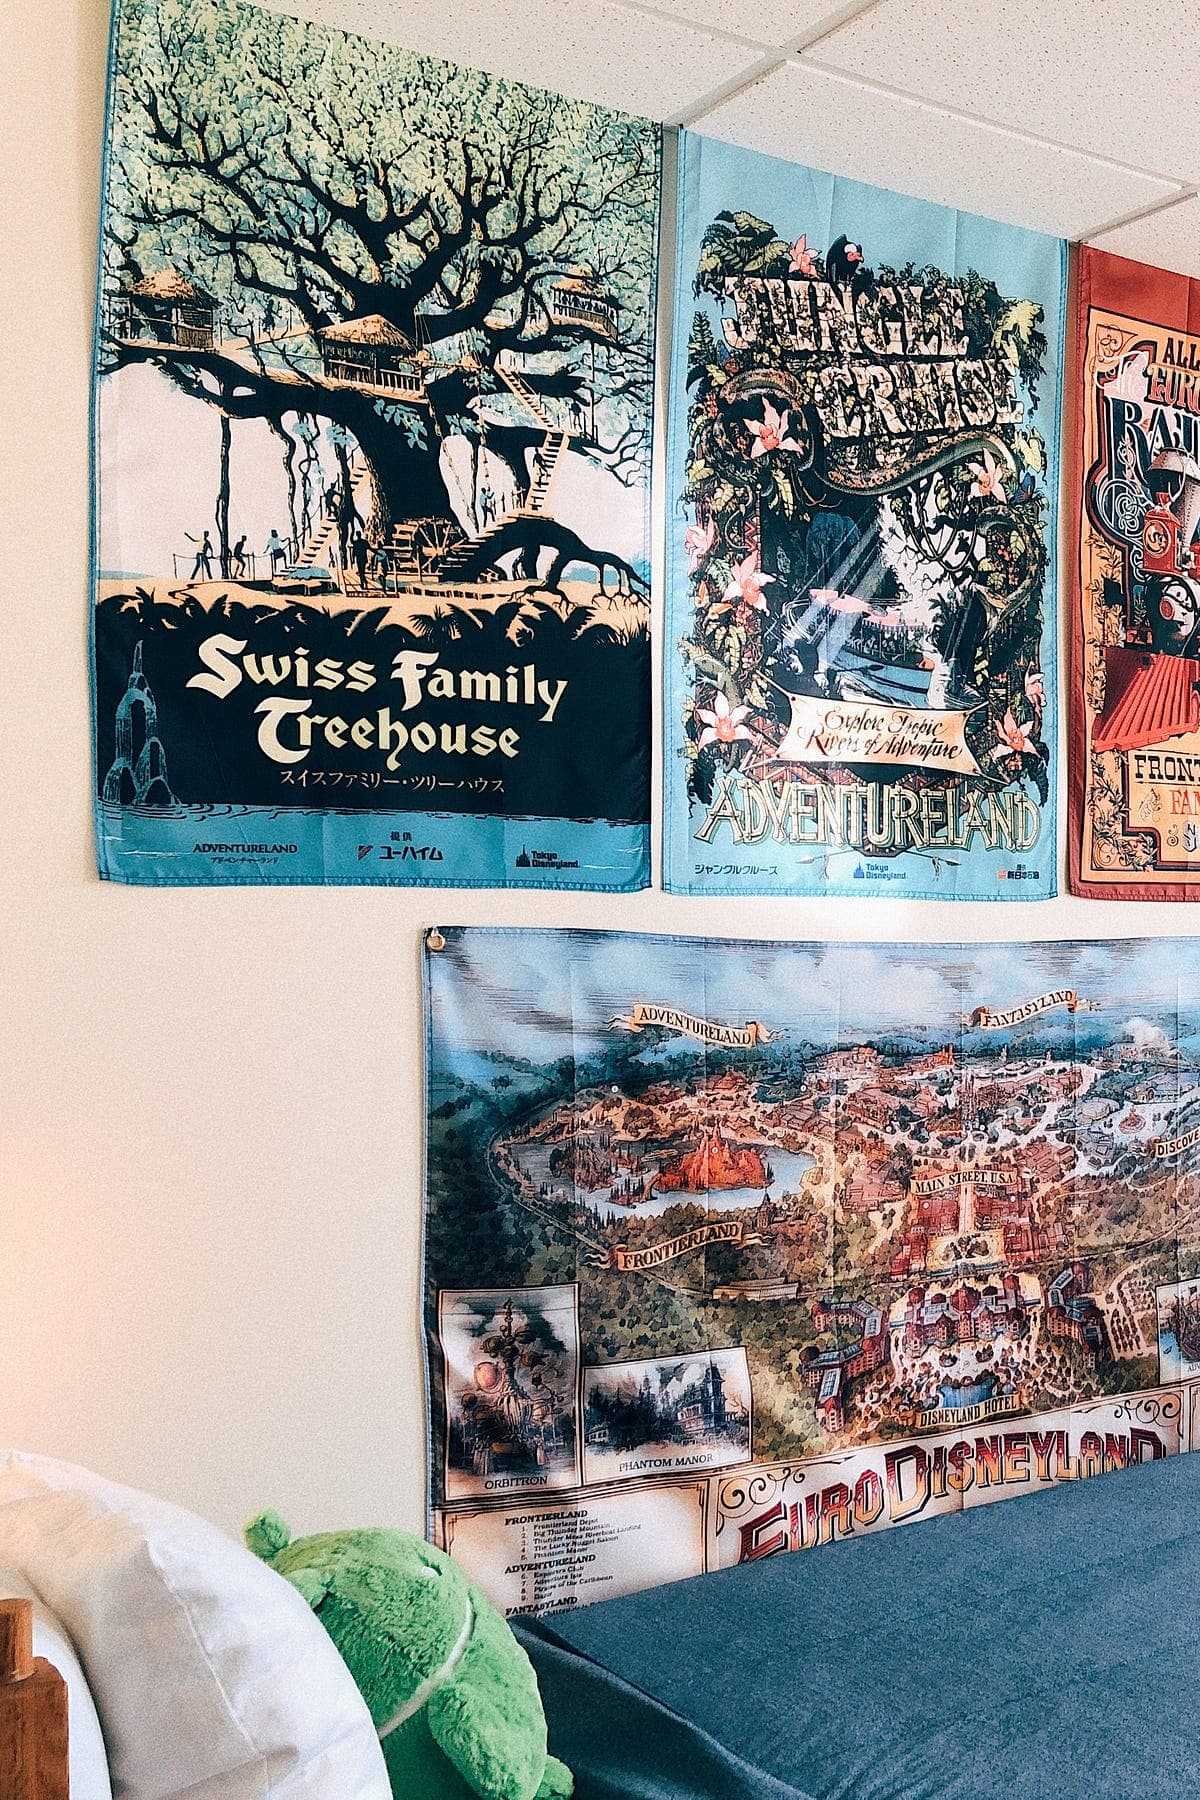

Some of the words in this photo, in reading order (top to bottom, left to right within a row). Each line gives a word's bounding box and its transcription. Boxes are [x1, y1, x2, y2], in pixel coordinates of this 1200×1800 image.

[721, 276, 968, 355] JUNGLE
[1163, 337, 1200, 371] ALL
[816, 359, 1024, 438] CRUISE
[185, 633, 377, 701] Swiss
[391, 650, 569, 722] Family
[824, 706, 885, 734] Explore
[888, 711, 949, 740] Tropic
[253, 697, 521, 771] Treehouse
[801, 723, 860, 756] Rivers
[864, 733, 878, 756] of
[876, 734, 963, 761] Adventure
[280, 769, 505, 794] スイスファミリー・ツリーハウス
[694, 775, 1042, 853] ADVENTURELAND
[193, 844, 298, 853] ADVENTURELAND
[379, 846, 444, 861] ユーハイム
[531, 851, 558, 861] Tokyo
[531, 860, 579, 870] Disneyland
[866, 863, 889, 872] Tokyo
[866, 871, 906, 881] Disneyland
[982, 990, 1073, 1026] FANTASYLAND
[639, 1006, 751, 1045] ADVENTURELAND
[915, 1177, 945, 1193] MAIN
[622, 1224, 740, 1270] FRONTIERLAND
[920, 1405, 981, 1426] DISNEYLAND
[984, 1395, 1017, 1418] HOTEL
[619, 1457, 672, 1472] PHANTOM
[675, 1454, 714, 1467] MANOR
[484, 1475, 548, 1490] ORBITRON
[505, 1510, 588, 1525] FRONTIERLAND
[534, 1520, 577, 1530] Frontierland
[533, 1536, 564, 1545] Thunder
[548, 1527, 577, 1536] Thunder
[505, 1554, 596, 1574] ADVENTURELAND
[505, 1597, 578, 1615] FANTASYLAND
